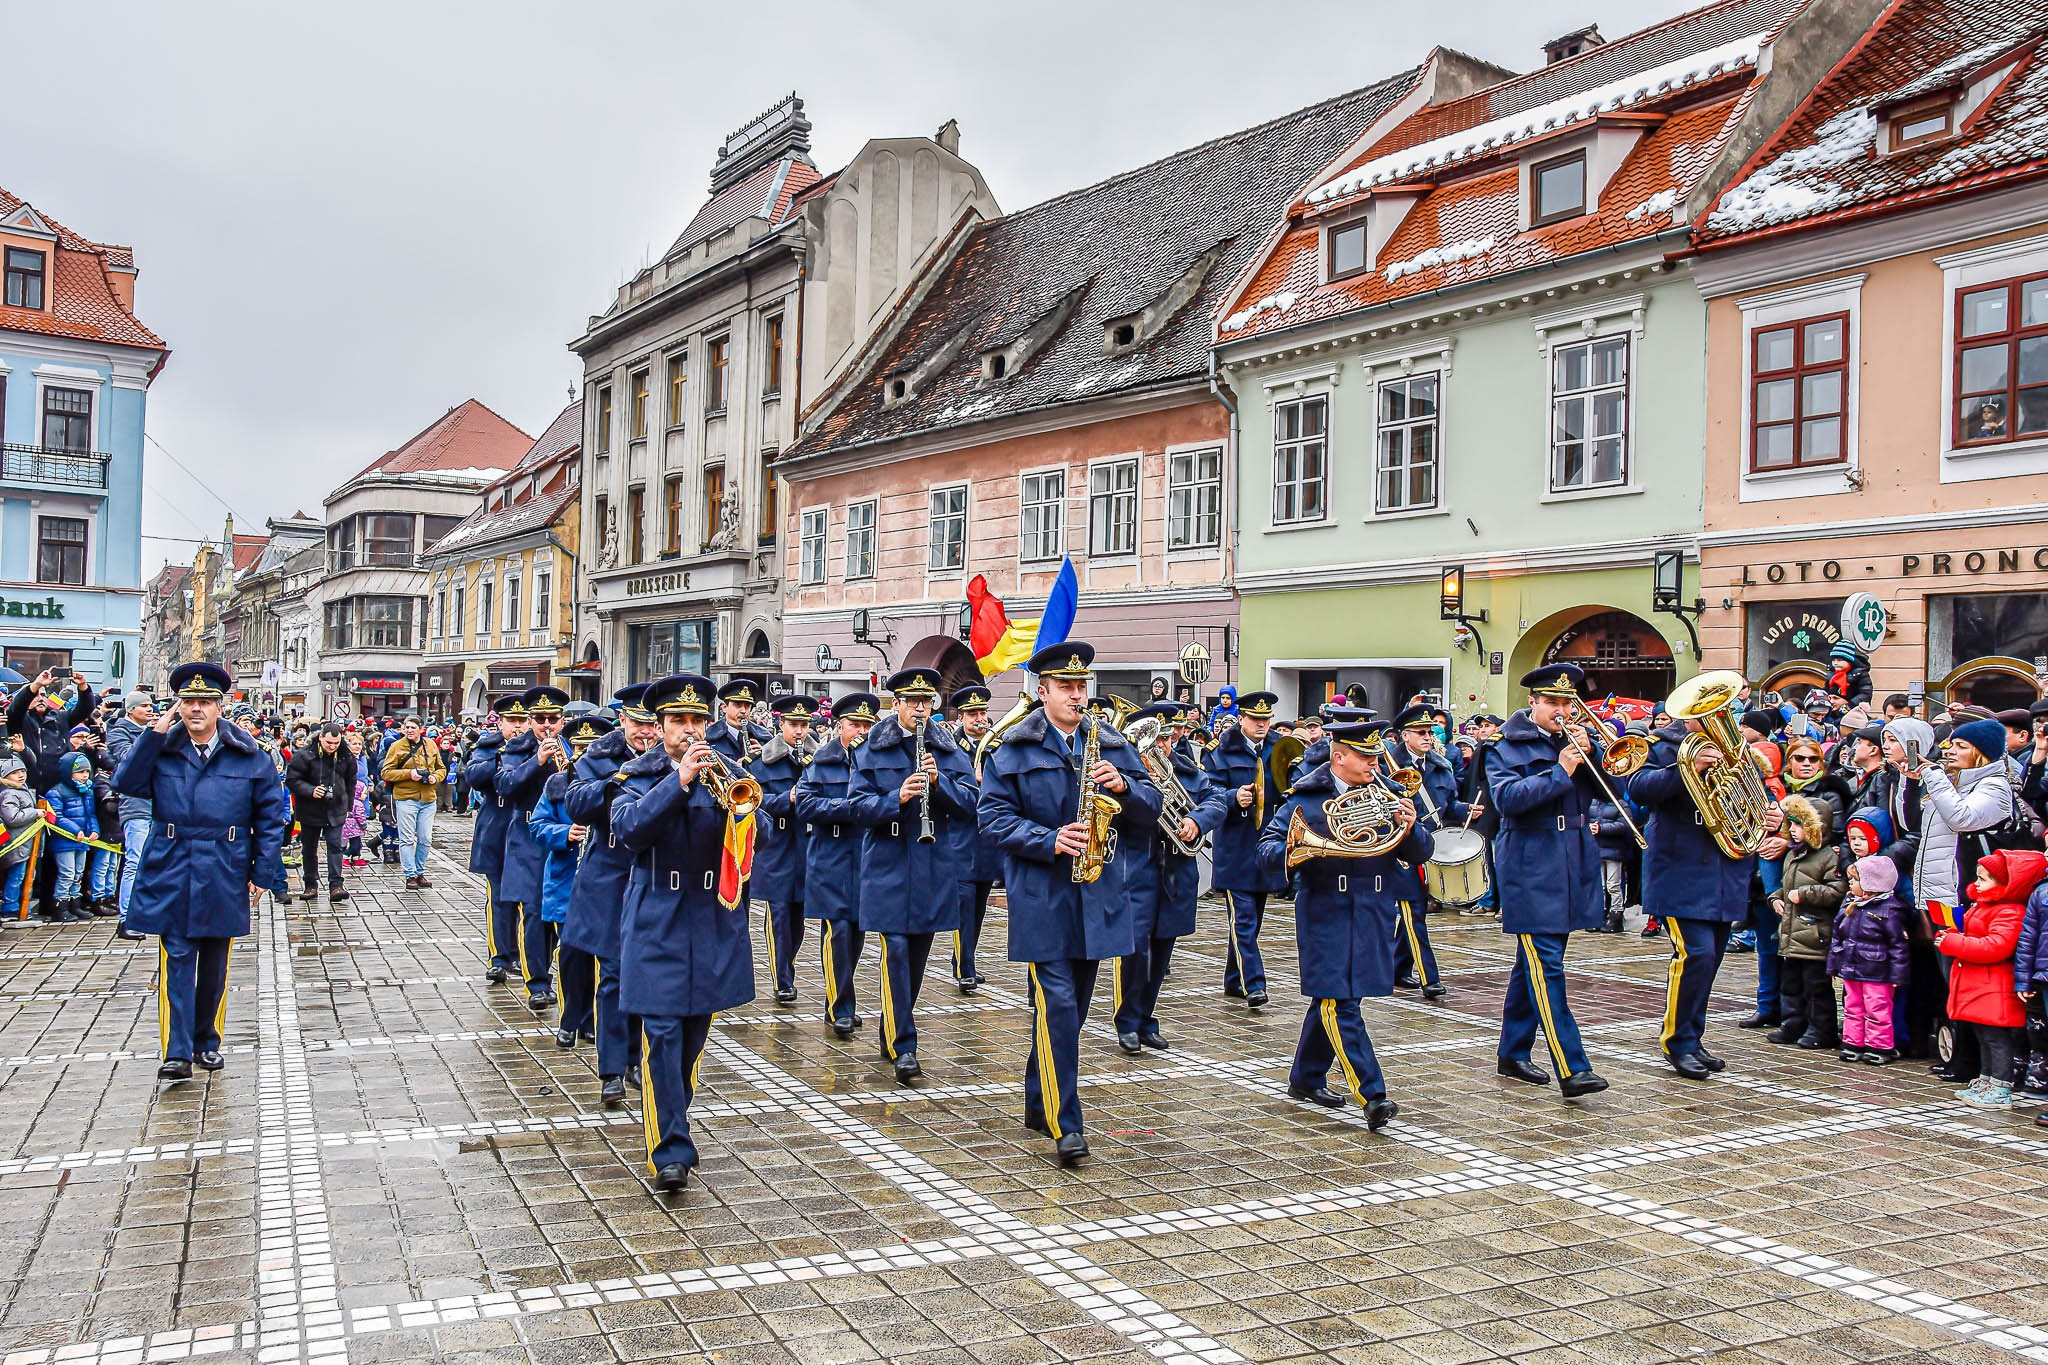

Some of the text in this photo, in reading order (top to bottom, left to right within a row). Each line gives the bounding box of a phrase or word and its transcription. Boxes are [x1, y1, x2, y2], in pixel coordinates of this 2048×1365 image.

[626, 572, 690, 596] BRASSERIE
[1742, 560, 1841, 586] LOTO
[1762, 613, 1840, 645] LOTO PRONO
